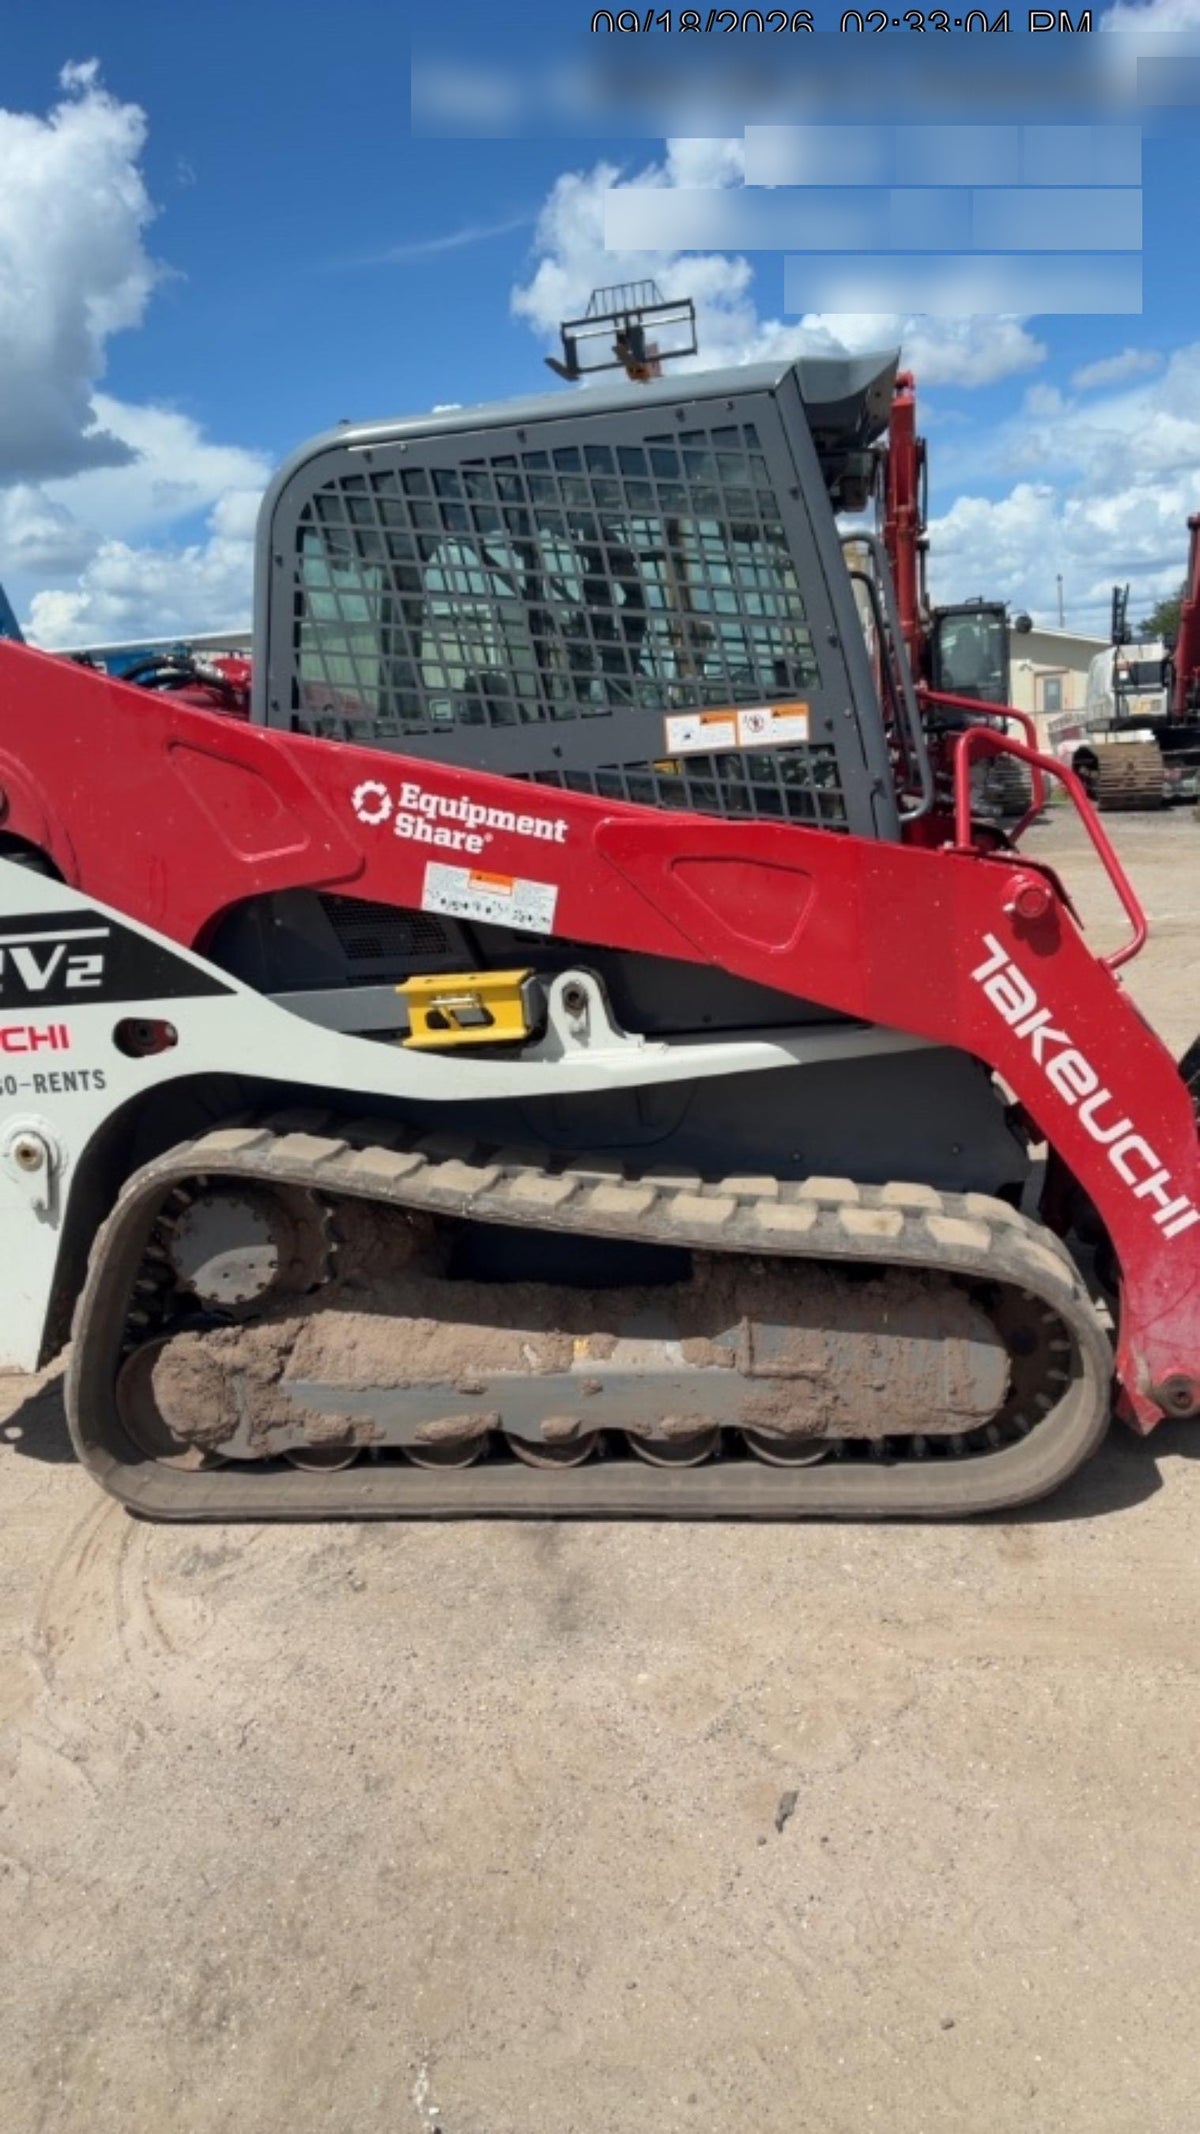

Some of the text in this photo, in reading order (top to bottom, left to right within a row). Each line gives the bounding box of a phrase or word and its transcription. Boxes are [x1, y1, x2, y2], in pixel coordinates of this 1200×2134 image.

[398, 782, 569, 843] Equipment
[0, 943, 104, 991] V2
[0, 1023, 70, 1052] CHI
[0, 1069, 107, 1096] 0-RENTS
